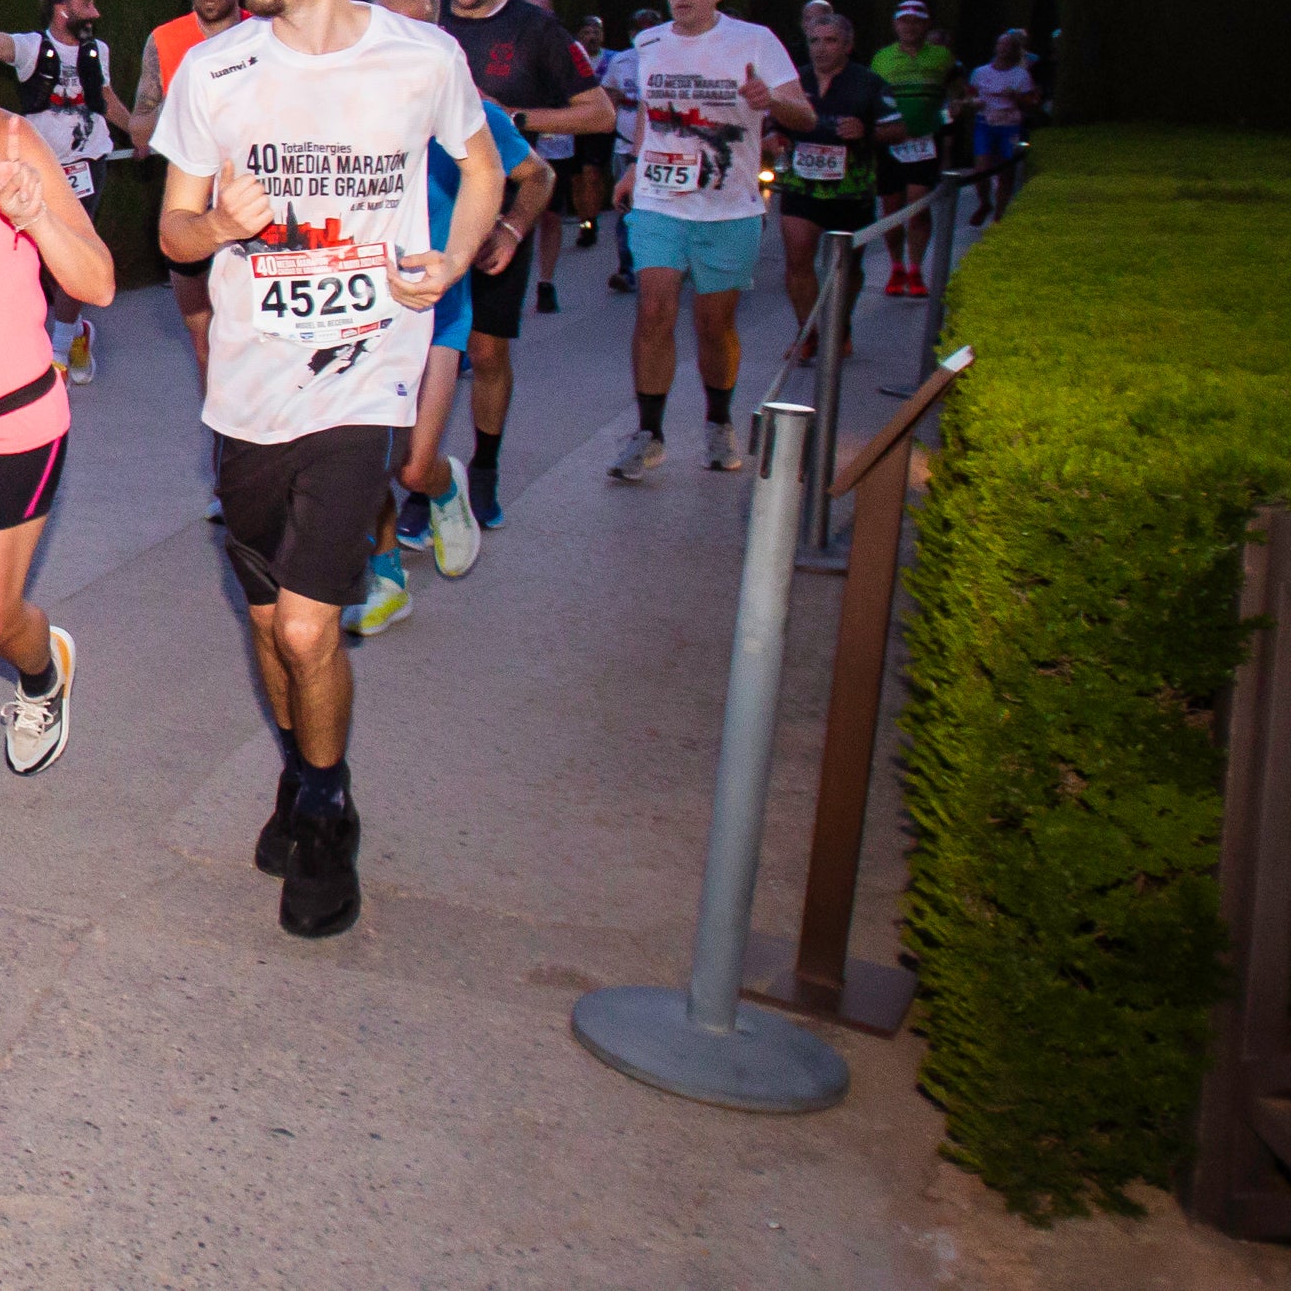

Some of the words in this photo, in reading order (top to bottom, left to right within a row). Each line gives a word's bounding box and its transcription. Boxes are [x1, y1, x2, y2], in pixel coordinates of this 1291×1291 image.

[210, 60, 247, 79] luanvi
[247, 143, 278, 175] 40
[281, 142, 353, 156] TotalEnergies
[282, 155, 332, 175] MEDIA
[337, 150, 410, 175] MARATÓN
[644, 164, 690, 185] 4575
[261, 176, 303, 197] UDAD
[309, 177, 330, 197] DE
[335, 173, 405, 198] GRANADA
[256, 255, 278, 276] 40
[261, 273, 376, 318] 4529
